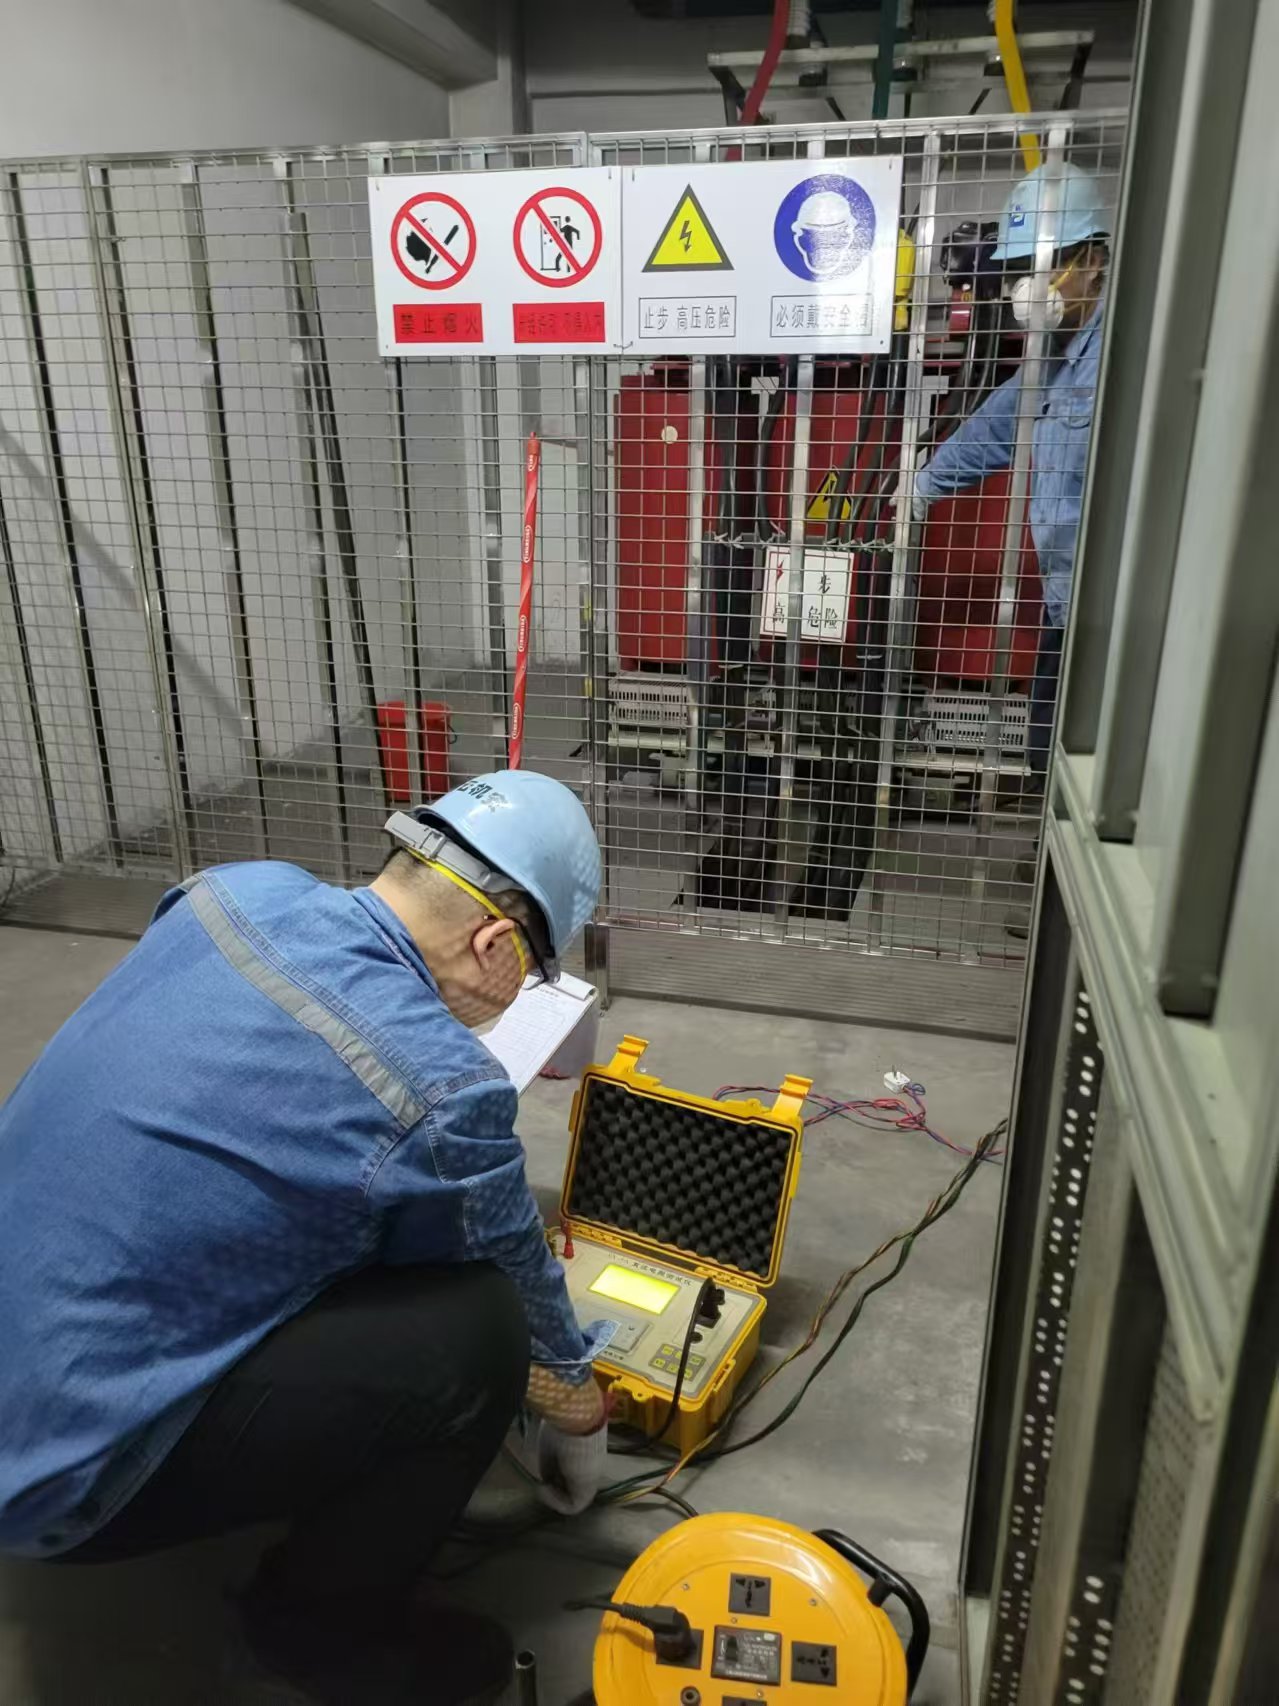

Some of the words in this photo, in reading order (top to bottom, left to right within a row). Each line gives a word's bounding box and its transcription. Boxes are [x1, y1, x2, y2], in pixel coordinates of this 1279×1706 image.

[643, 305, 669, 330] 止步
[676, 304, 731, 330] 高压危险
[772, 601, 838, 629] 高危险
